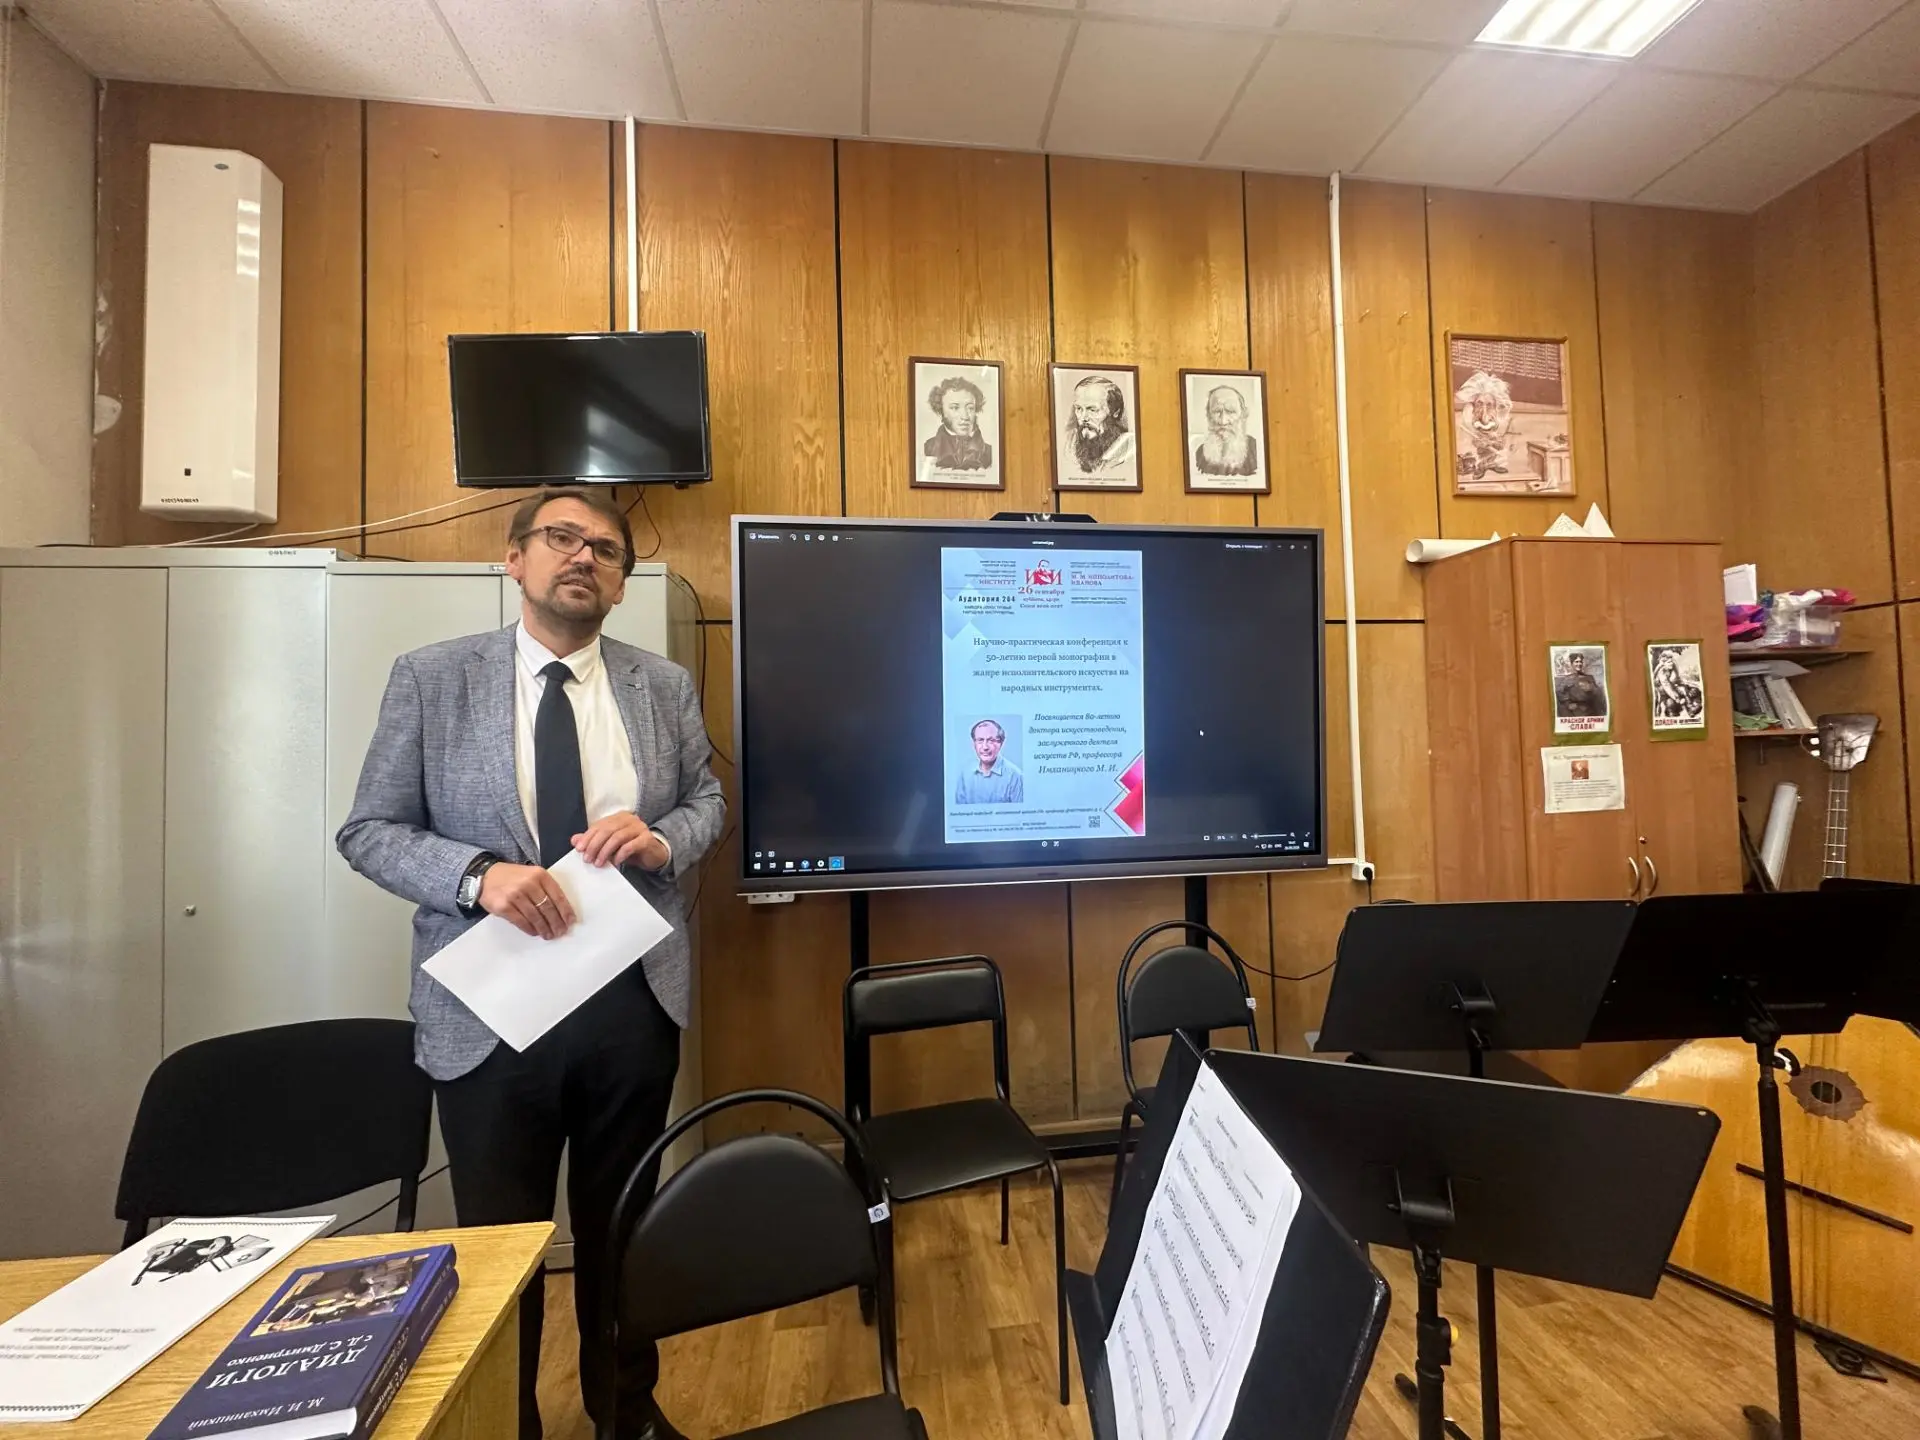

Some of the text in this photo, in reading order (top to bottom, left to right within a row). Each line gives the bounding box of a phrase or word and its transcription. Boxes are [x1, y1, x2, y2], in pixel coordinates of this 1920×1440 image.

[1018, 586, 1033, 595] 26
[958, 595, 1000, 603] Аудитория
[973, 637, 1065, 648] Научно-практическая
[1066, 637, 1121, 648] конференция
[985, 654, 1026, 663] 50-летию
[1027, 653, 1057, 662] первой
[1059, 653, 1109, 663] монографии
[972, 670, 1000, 678] жанре
[1001, 669, 1077, 677] исполнительского
[1078, 669, 1118, 678] искусства
[1001, 684, 1103, 694] народных инструментах.
[1034, 713, 1084, 721] Посвящается
[1028, 726, 1060, 735] доктора
[226, 1334, 373, 1367] с Д. С. Дмитриенко
[205, 1345, 368, 1390] ДИАЛОГИ
[187, 1396, 325, 1431] М. И. Имханицкий
